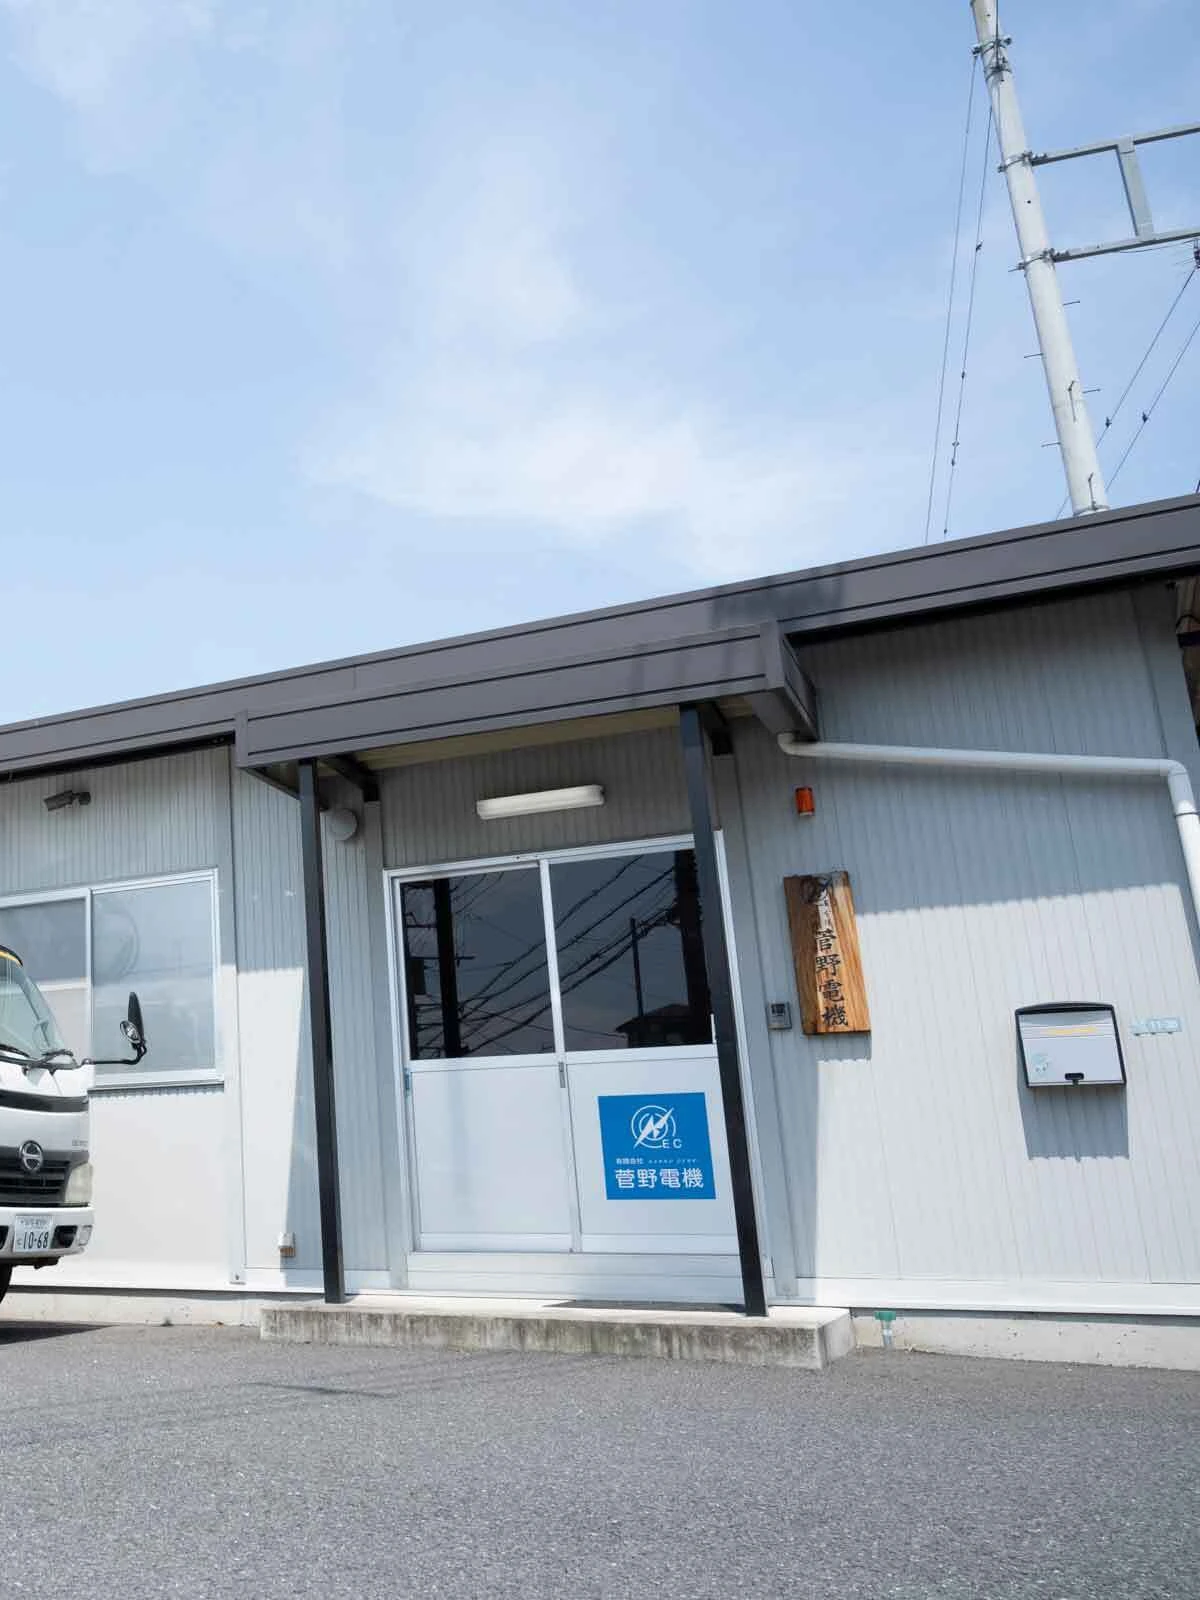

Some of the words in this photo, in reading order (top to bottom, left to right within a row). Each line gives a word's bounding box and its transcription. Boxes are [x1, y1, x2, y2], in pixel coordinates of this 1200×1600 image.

[615, 1167, 704, 1189] 菅野電機
[23, 1231, 50, 1250] 10-68
